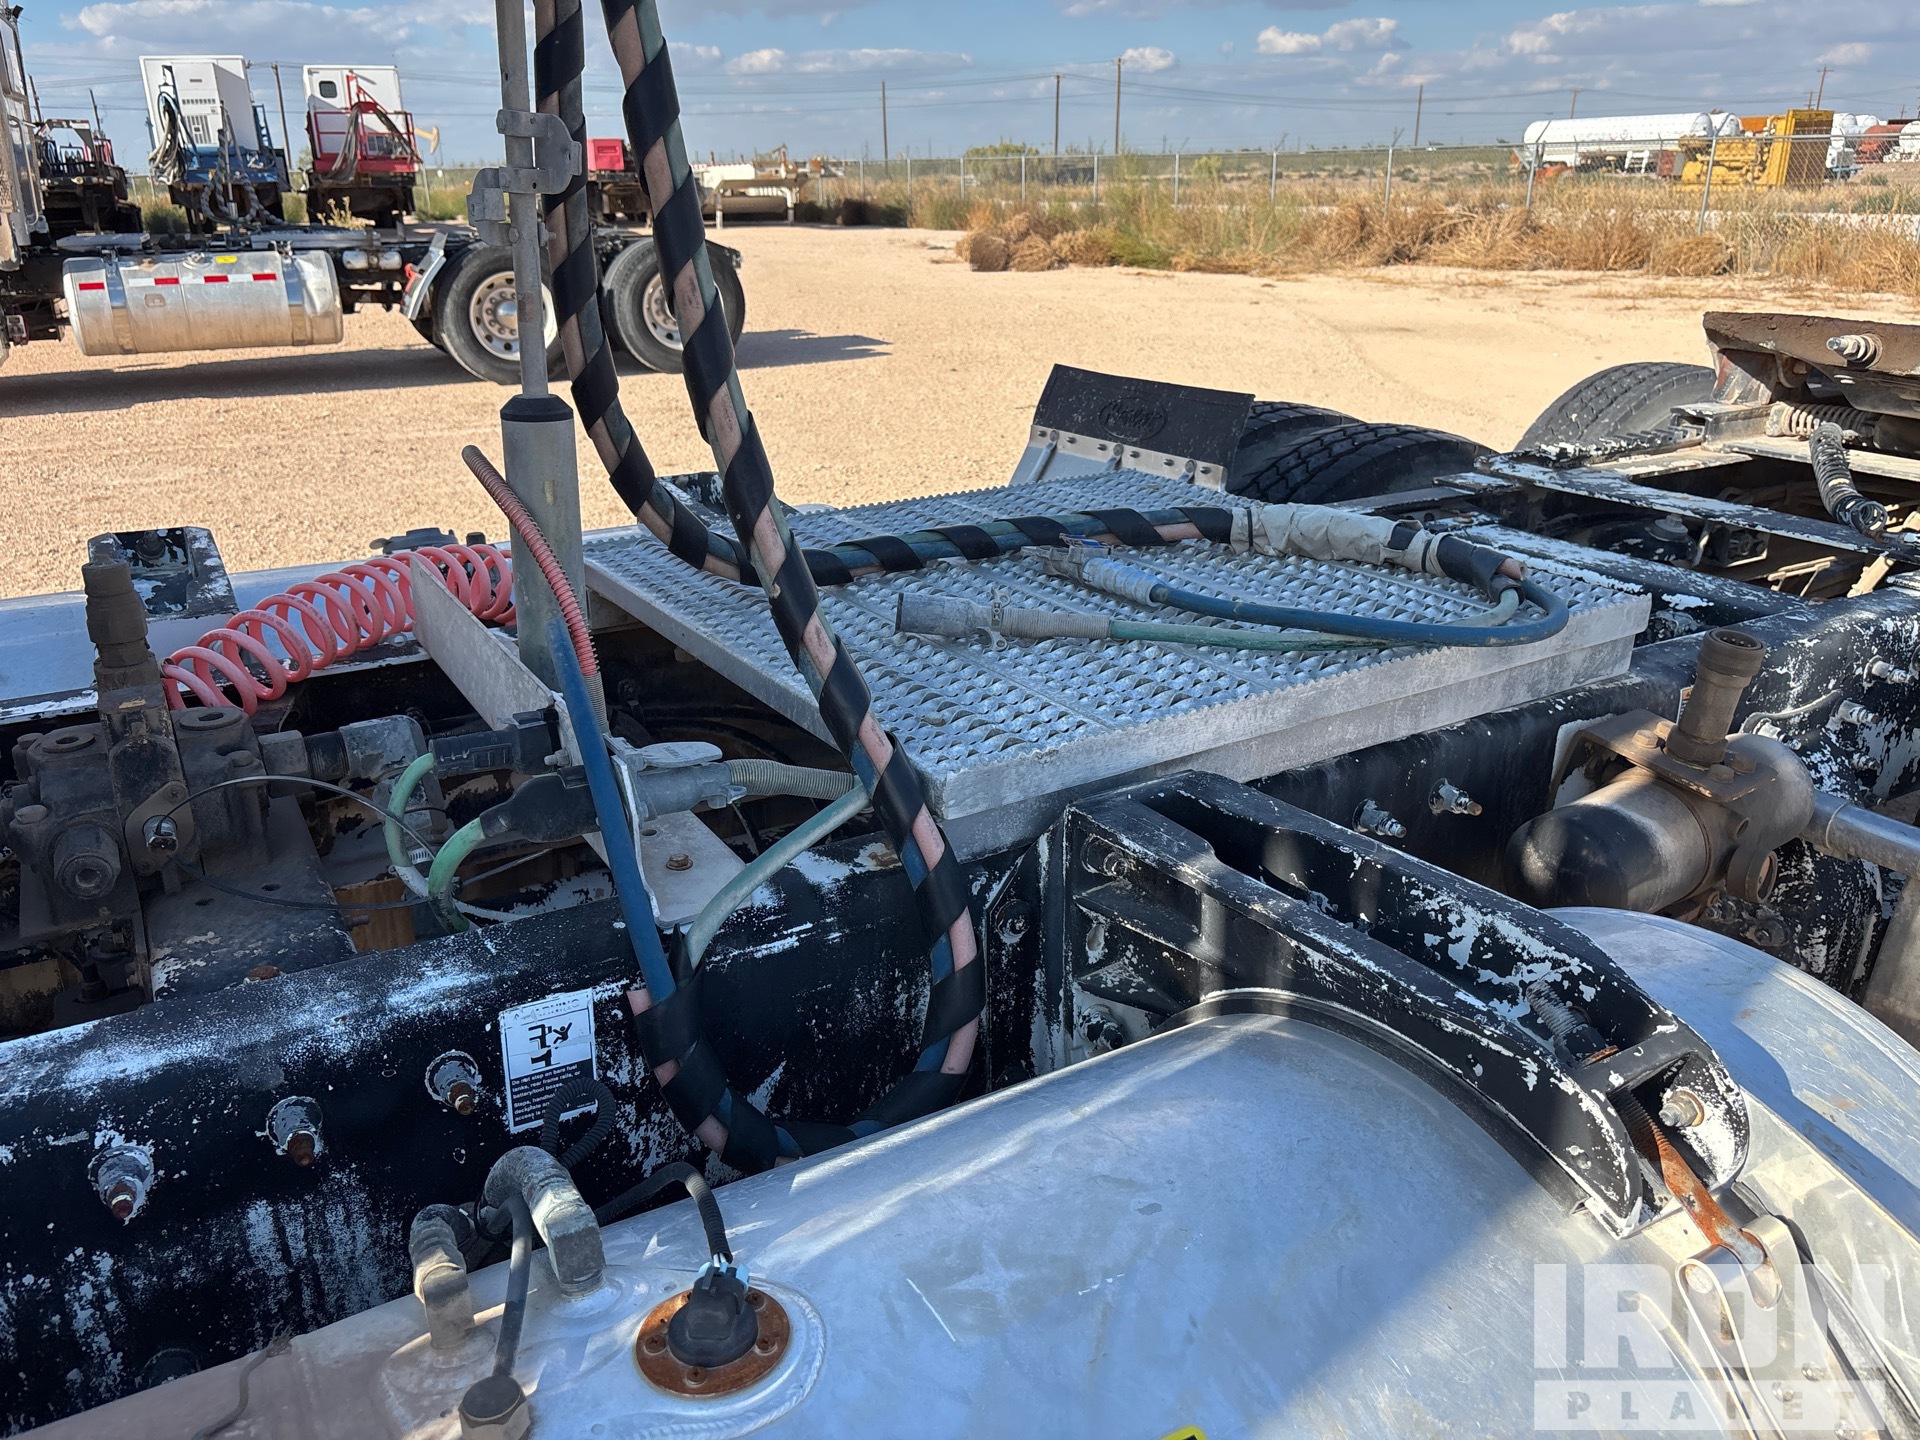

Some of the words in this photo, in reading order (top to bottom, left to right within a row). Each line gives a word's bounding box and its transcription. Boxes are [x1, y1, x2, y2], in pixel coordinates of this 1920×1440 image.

[531, 1073, 544, 1081] step
[553, 1067, 566, 1075] bare
[512, 1085, 530, 1093] tanks,
[543, 1076, 559, 1084] frame
[513, 1100, 532, 1108] Steps,
[532, 1092, 556, 1103] handhol
[514, 1103, 542, 1115] deckplate
